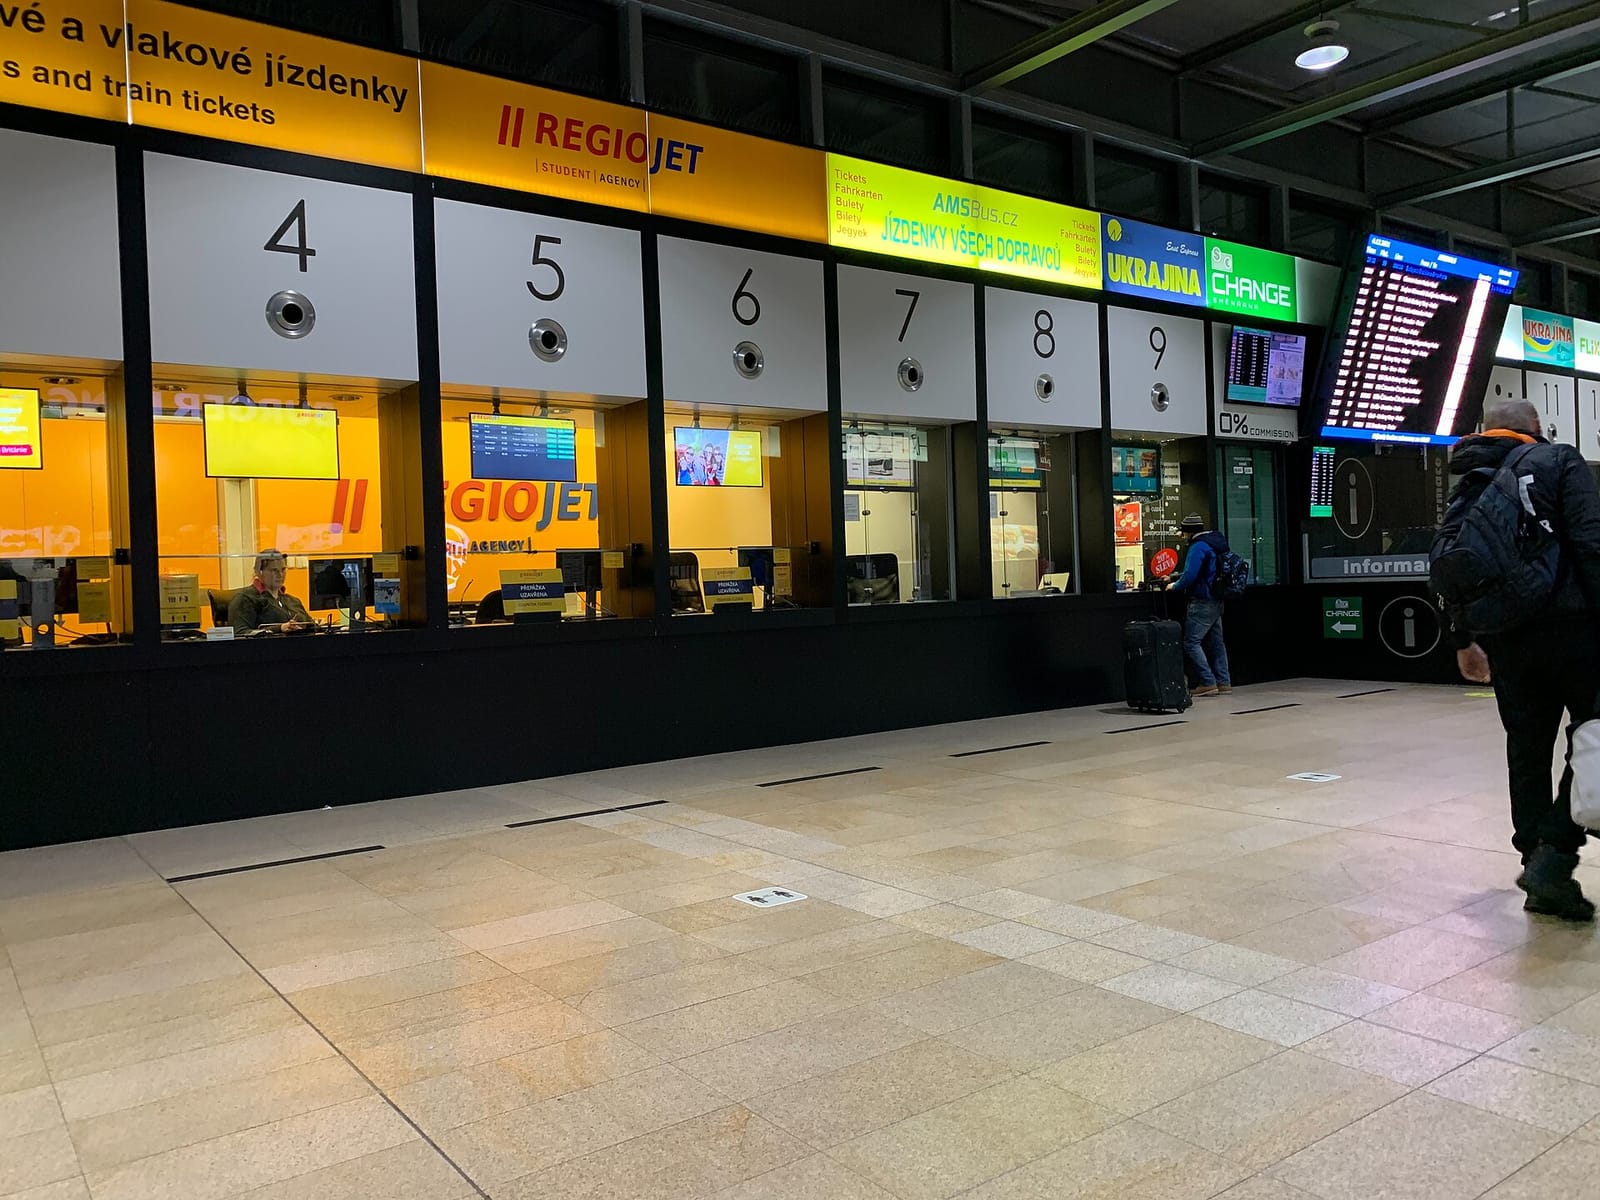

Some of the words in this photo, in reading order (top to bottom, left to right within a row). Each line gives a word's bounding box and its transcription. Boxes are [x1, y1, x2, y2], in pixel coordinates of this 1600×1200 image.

[0, 3, 45, 34] vé
[62, 17, 84, 42] a
[100, 20, 252, 75] vlakové
[265, 53, 408, 113] jízdenky
[2, 59, 21, 79] s
[32, 63, 92, 92] and
[103, 74, 172, 106] train
[182, 89, 276, 126] tickets
[535, 112, 704, 175] REGIOJET
[835, 168, 867, 184] Tickets
[835, 182, 883, 201] Fahrkarten
[264, 199, 316, 272] 4
[836, 210, 862, 225] Bilety
[1061, 229, 1097, 244] Fahrkarten
[1072, 220, 1096, 233] Tickets
[881, 210, 947, 250] JÍZDENKY
[951, 223, 993, 259] VŠECH
[997, 243, 1061, 271] DOPRAVCŮ
[527, 234, 565, 301] 5
[1107, 252, 1201, 297] UKRAJINA
[1212, 272, 1291, 307] CHANGE
[732, 268, 760, 325] 6
[896, 289, 920, 342] 7
[1034, 310, 1055, 358] 8
[1150, 327, 1166, 370] 9
[1544, 383, 1559, 416] 11
[1220, 412, 1248, 435] 0%
[1250, 427, 1295, 439] COMMISSION
[470, 540, 525, 553] AGENCY
